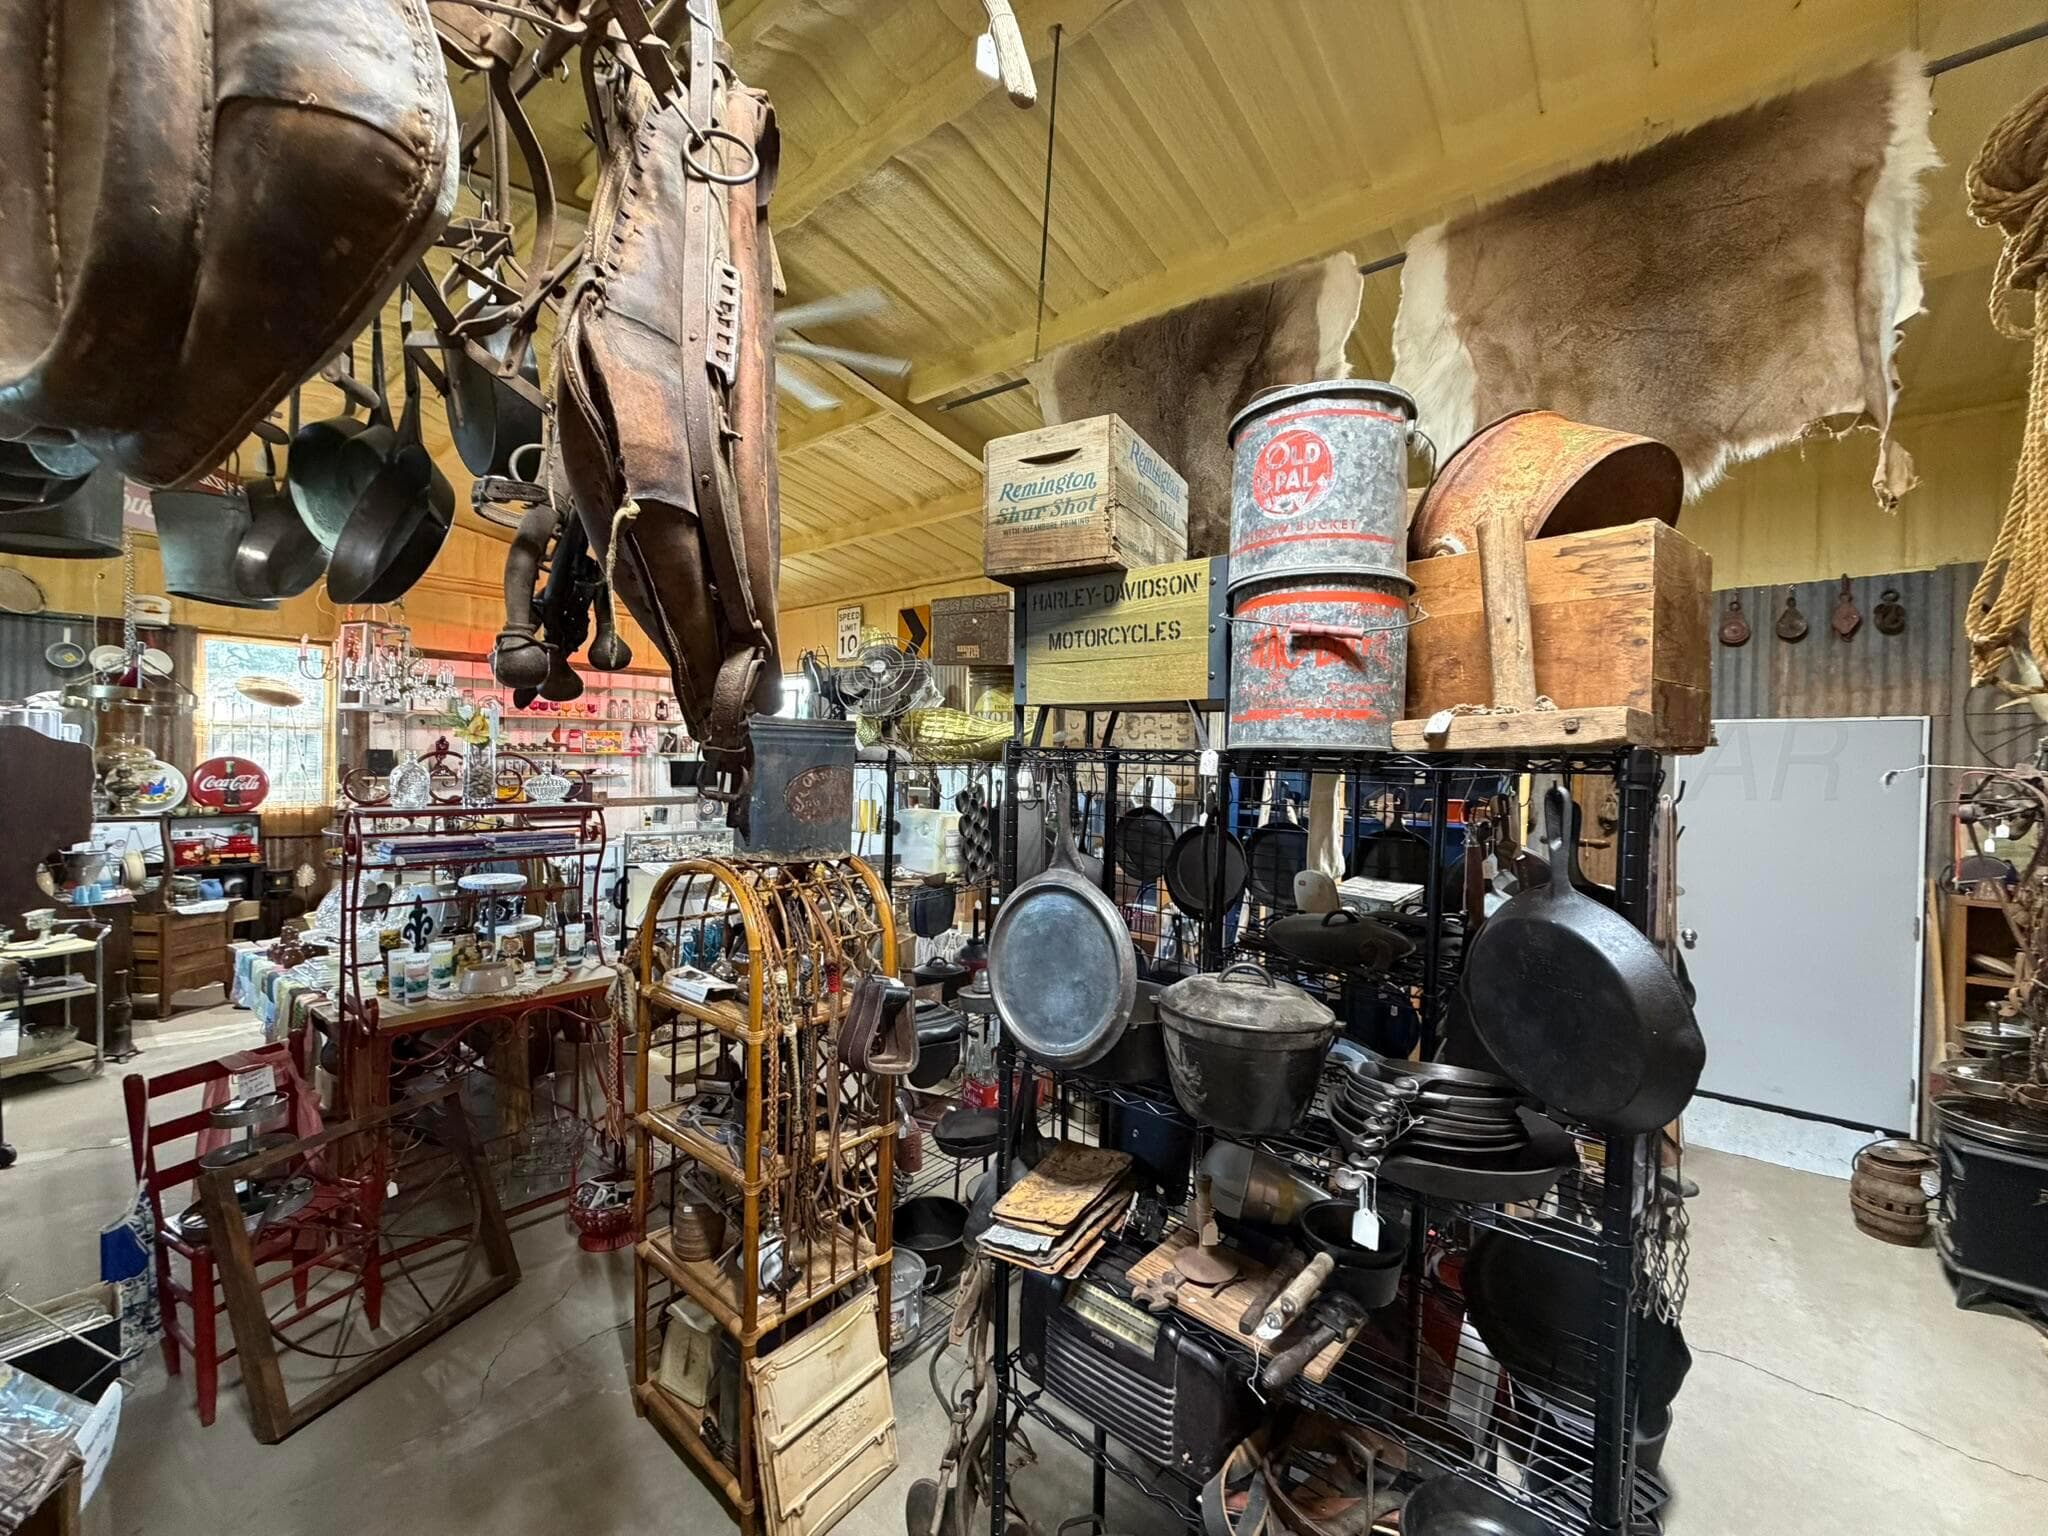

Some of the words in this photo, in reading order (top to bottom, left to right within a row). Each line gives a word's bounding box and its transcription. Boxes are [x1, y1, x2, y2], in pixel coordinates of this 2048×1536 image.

[1266, 441, 1321, 469] OLD
[1130, 438, 1181, 503] Remington
[1275, 466, 1314, 493] PAL
[999, 471, 1097, 503] Remington
[997, 504, 1050, 525] Shur
[1050, 494, 1098, 517] Shot
[1295, 518, 1358, 532] BUCKET
[1032, 571, 1200, 612] HARLEY-DAVIDSON
[839, 611, 860, 621] SPEED
[841, 623, 857, 632] LIMIT
[840, 634, 858, 654] 10
[1048, 620, 1182, 651] MOTORCYCLES
[199, 775, 260, 792] Coca-Cola
